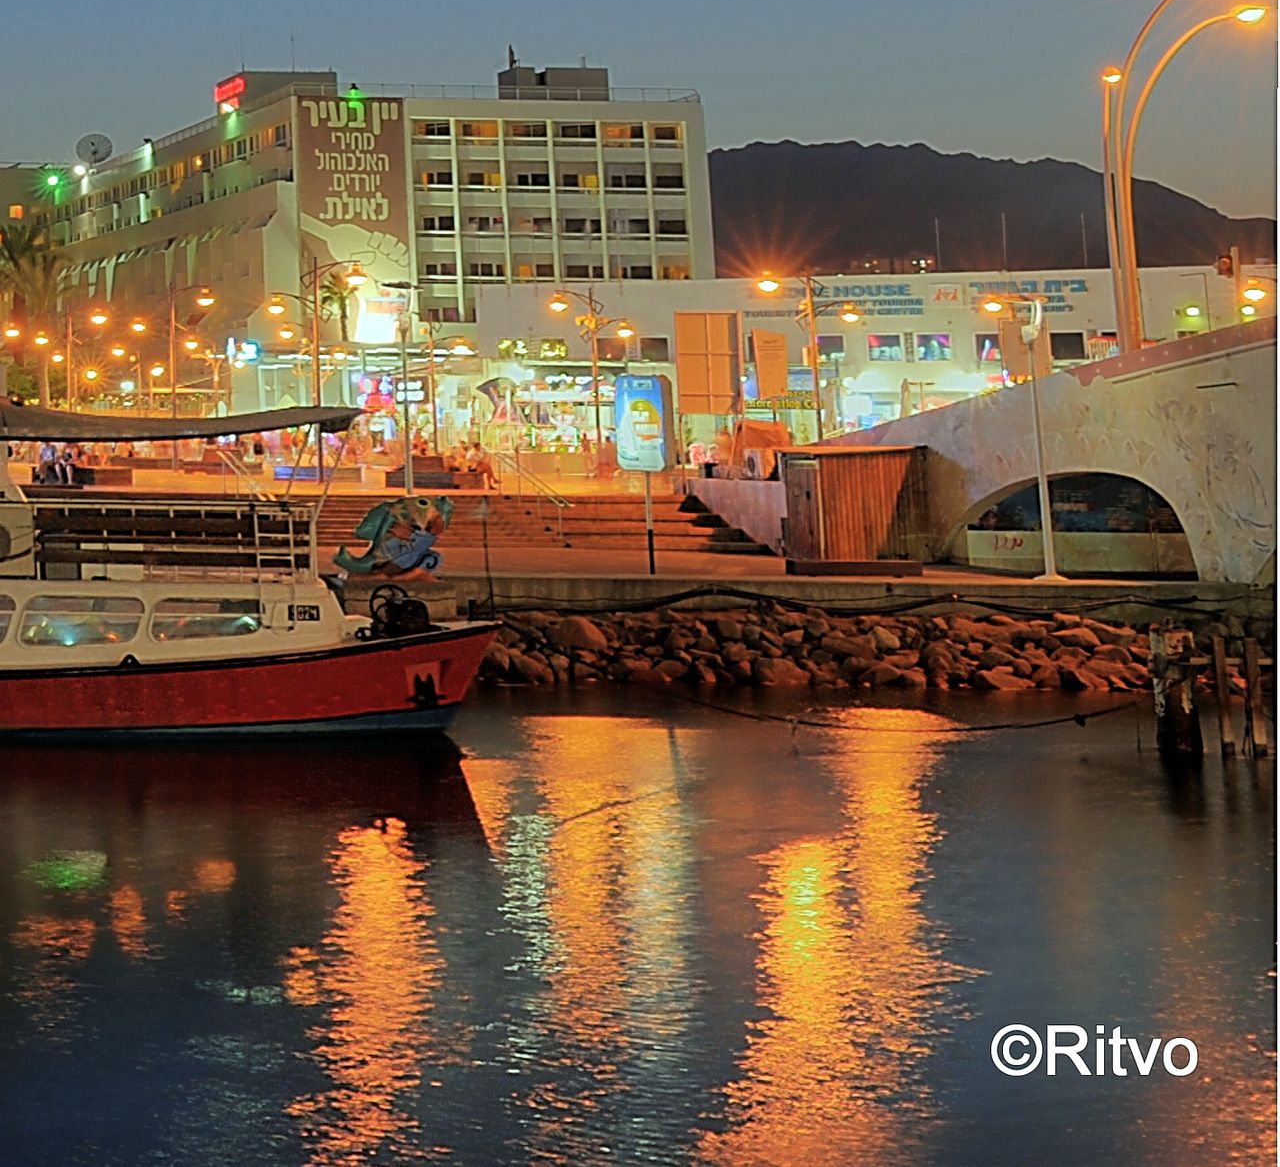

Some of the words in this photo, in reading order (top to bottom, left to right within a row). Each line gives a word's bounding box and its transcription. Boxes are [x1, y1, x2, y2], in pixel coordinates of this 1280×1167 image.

[302, 101, 366, 128] בעיר
[372, 102, 398, 135] יין
[332, 132, 375, 150] מחירי
[315, 149, 389, 171] האלכוהול
[329, 174, 380, 192] יורדים.
[320, 192, 389, 220] לאילת.
[833, 284, 912, 298] HOUSE
[1043, 280, 1088, 293] בית
